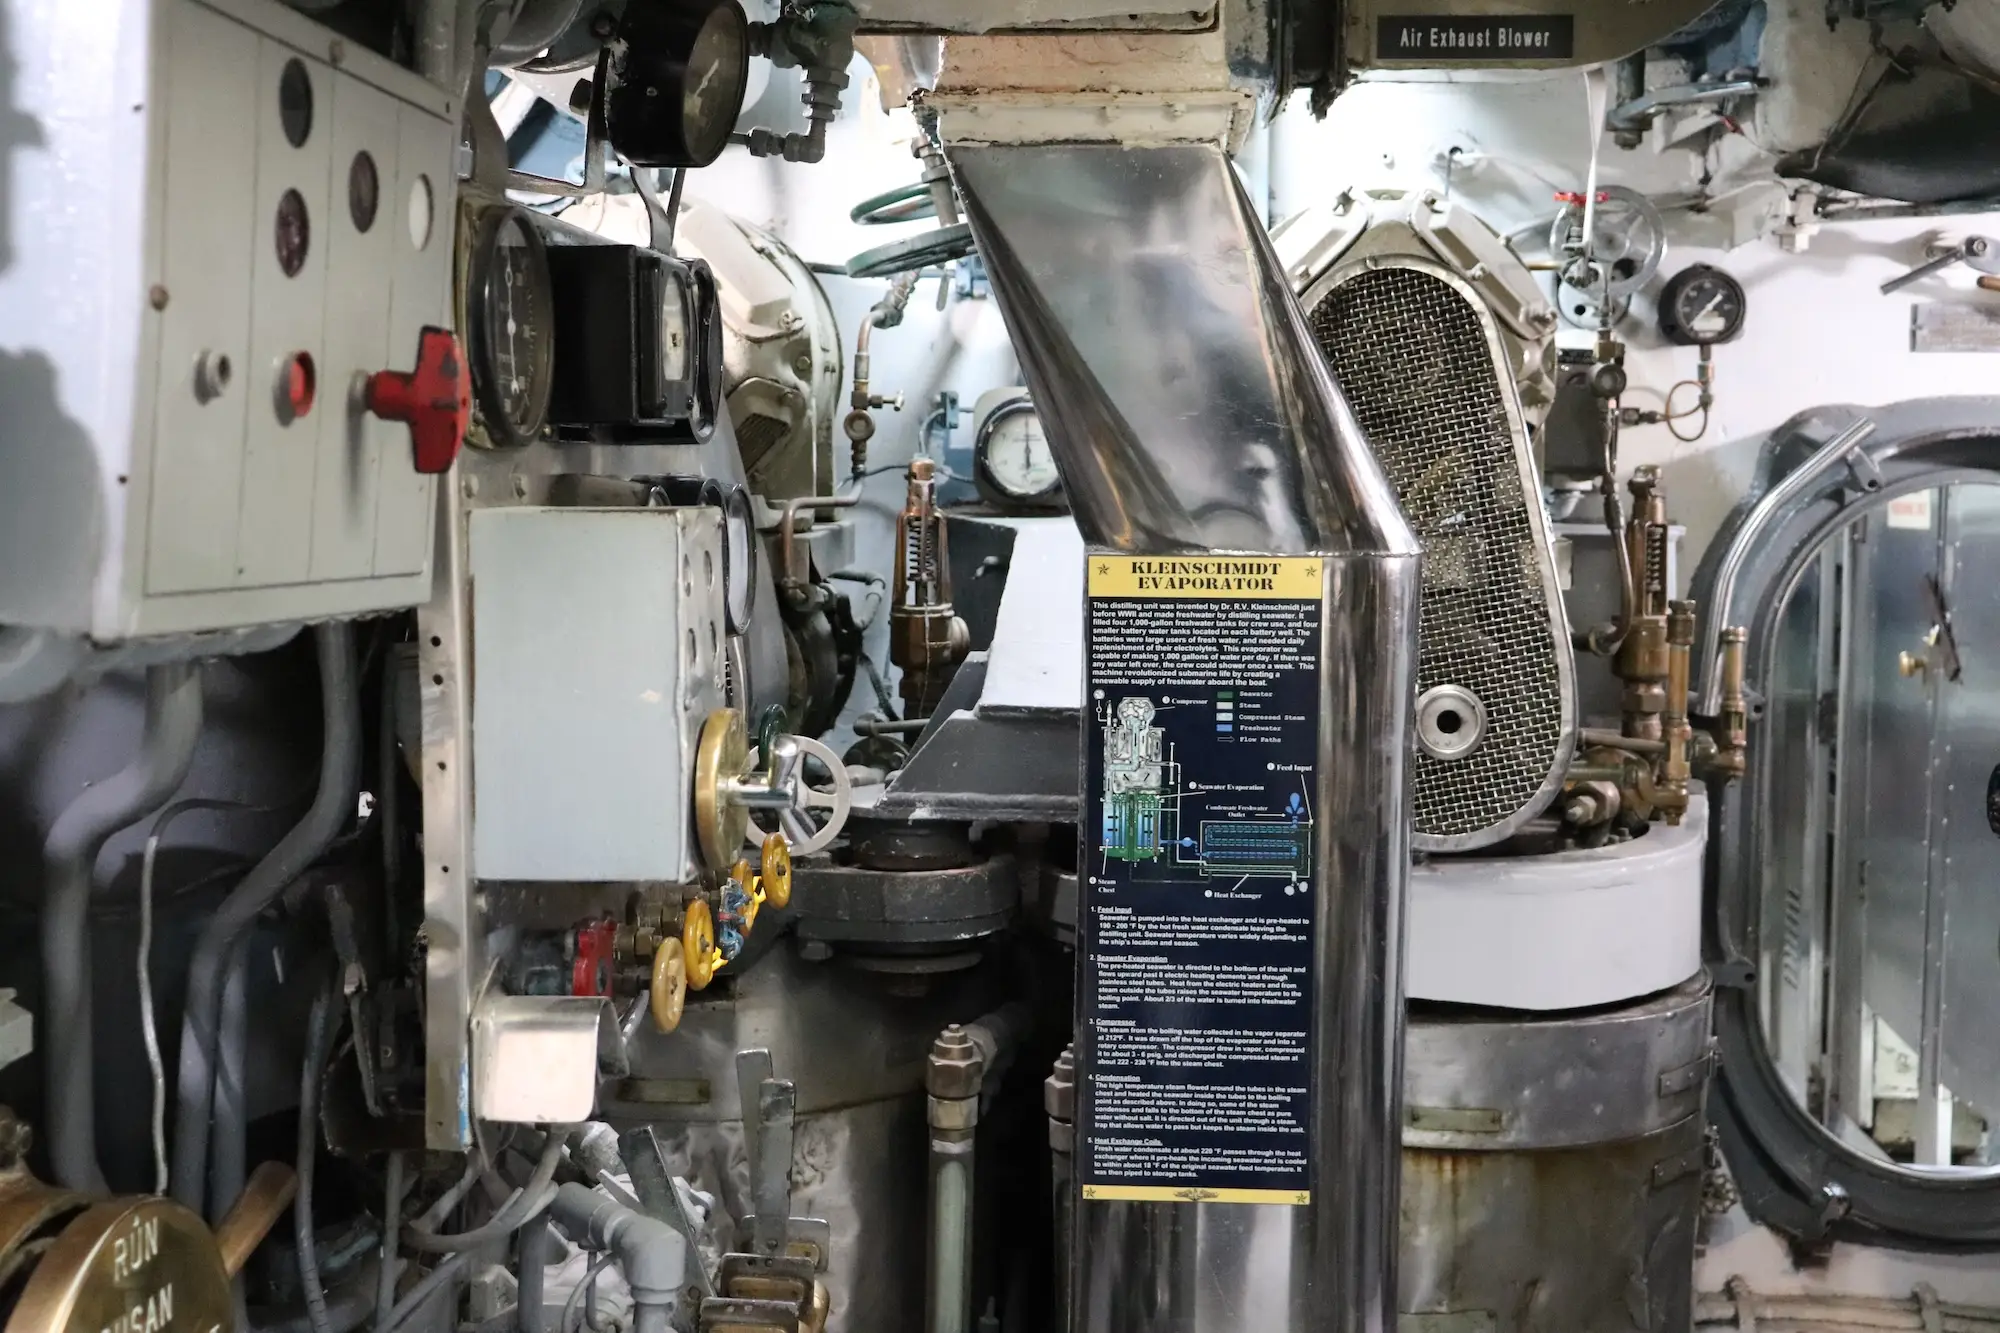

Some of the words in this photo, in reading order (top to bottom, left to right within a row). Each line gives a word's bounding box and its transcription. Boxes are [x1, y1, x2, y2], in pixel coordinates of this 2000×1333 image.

[1400, 27, 1422, 47] Air
[1430, 27, 1490, 47] Exhaust
[1498, 27, 1550, 47] Blower
[1131, 562, 1282, 575] KLEINSCHMIDT
[1138, 576, 1274, 590] EVAPORATOR
[1110, 602, 1142, 610] distilling
[1210, 603, 1219, 611] by
[1301, 604, 1315, 612] just
[1217, 611, 1226, 620] by
[1228, 611, 1260, 620] distilling
[1130, 619, 1173, 628] 1,000-gallon
[1121, 627, 1146, 636] battery
[1250, 628, 1276, 637] battery
[1145, 636, 1164, 644] large
[1287, 637, 1305, 645] daily
[1092, 644, 1144, 652] replenishment
[1174, 644, 1219, 653] electrolytes.
[1241, 645, 1280, 653] evaporator
[1092, 652, 1120, 660] capable
[1131, 652, 1159, 661] making
[1181, 653, 1209, 661] gallons
[1256, 654, 1271, 662] day.
[1232, 670, 1241, 678] by
[1243, 670, 1274, 679] creating
[1131, 677, 1155, 686] supply
[1138, 914, 1165, 923] pumped
[1208, 916, 1243, 924] exchanger
[1266, 916, 1301, 925] pre-heated
[1110, 938, 1130, 946] ship's
[1095, 1074, 1140, 1082] Condensation
[114, 1216, 158, 1283] RUN
